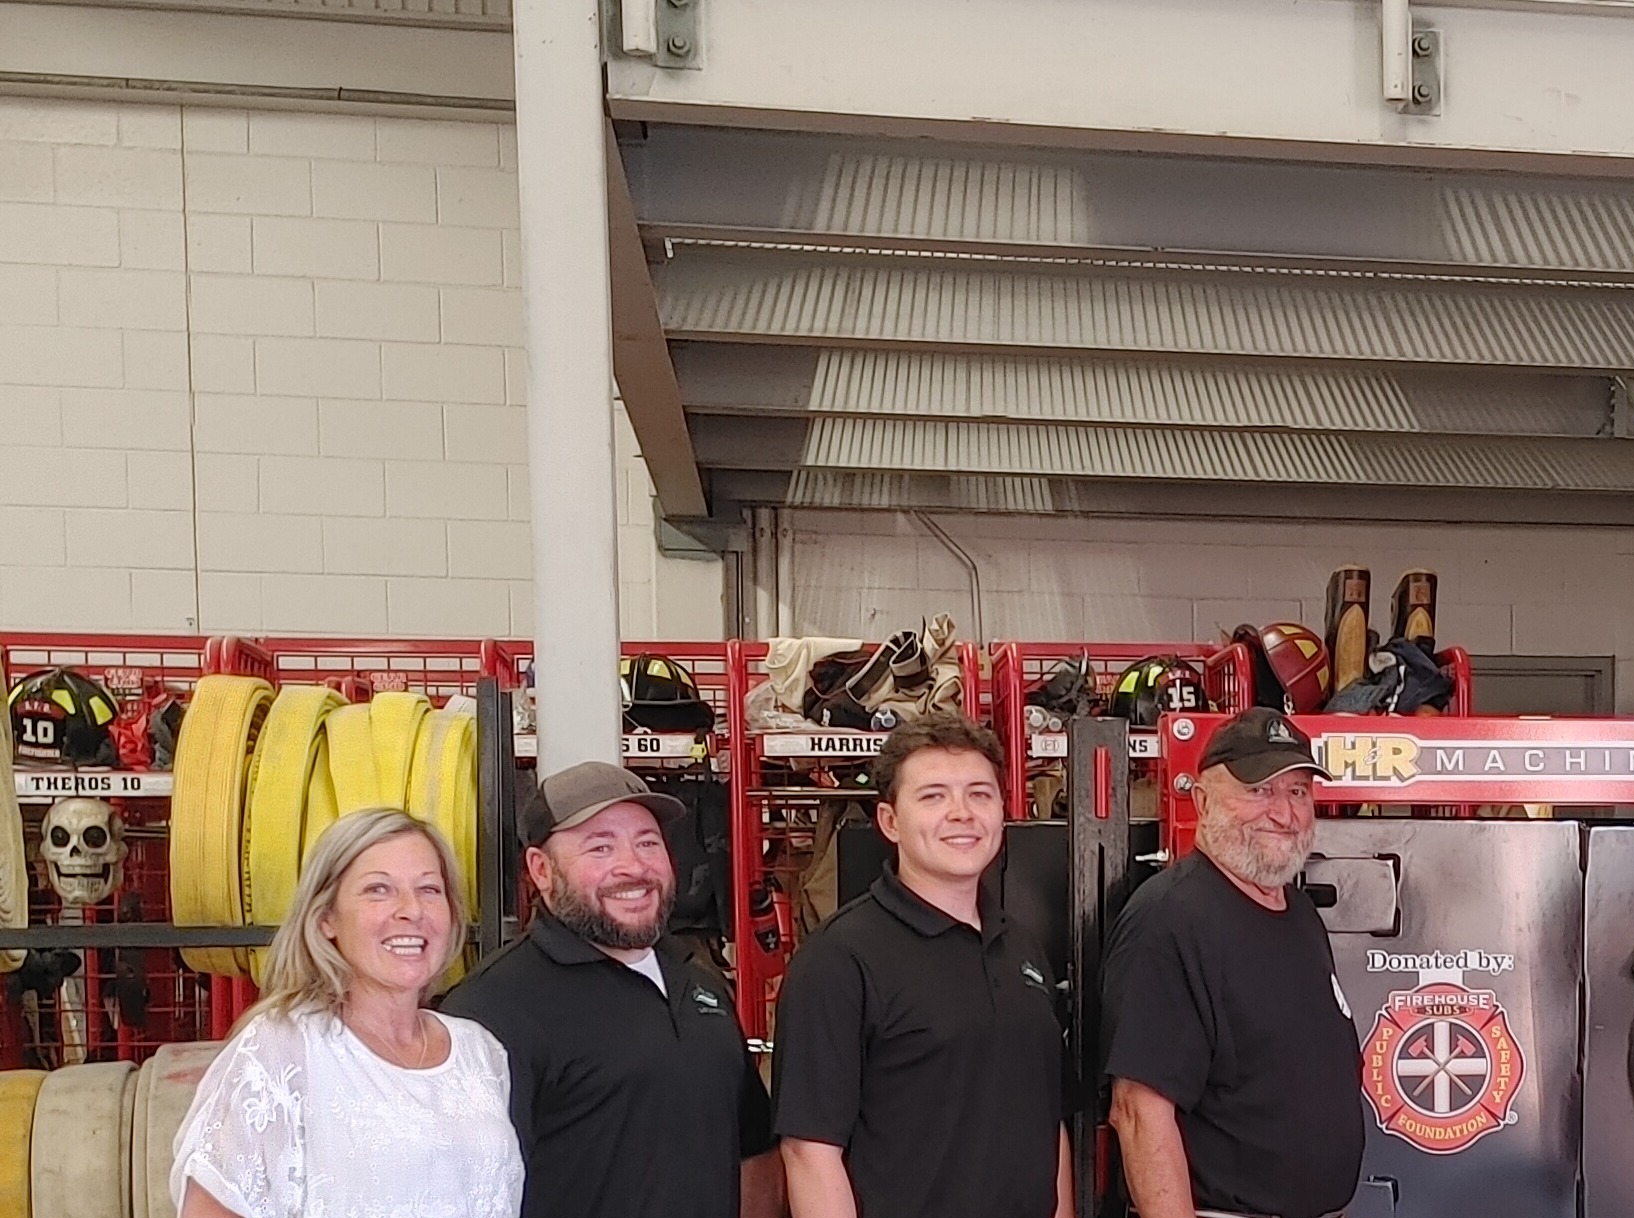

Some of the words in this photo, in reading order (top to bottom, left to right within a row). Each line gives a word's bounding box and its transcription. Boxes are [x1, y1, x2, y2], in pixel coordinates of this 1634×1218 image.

[1167, 686, 1196, 709] 15
[22, 717, 54, 744] 10
[637, 737, 661, 753] 60
[810, 737, 884, 753] HARRIS
[1326, 736, 1421, 780] H&R
[31, 776, 112, 792] THEROS
[121, 776, 142, 792] 10
[1367, 951, 1470, 971] Donated
[1478, 952, 1514, 975] by:
[1394, 994, 1491, 1011] FIREHOUSE
[1425, 1006, 1461, 1016] SUBS
[1371, 1027, 1394, 1108] PUBLIC
[1490, 1025, 1512, 1104] SAFETY
[1397, 1112, 1488, 1140] FOUNDATION
